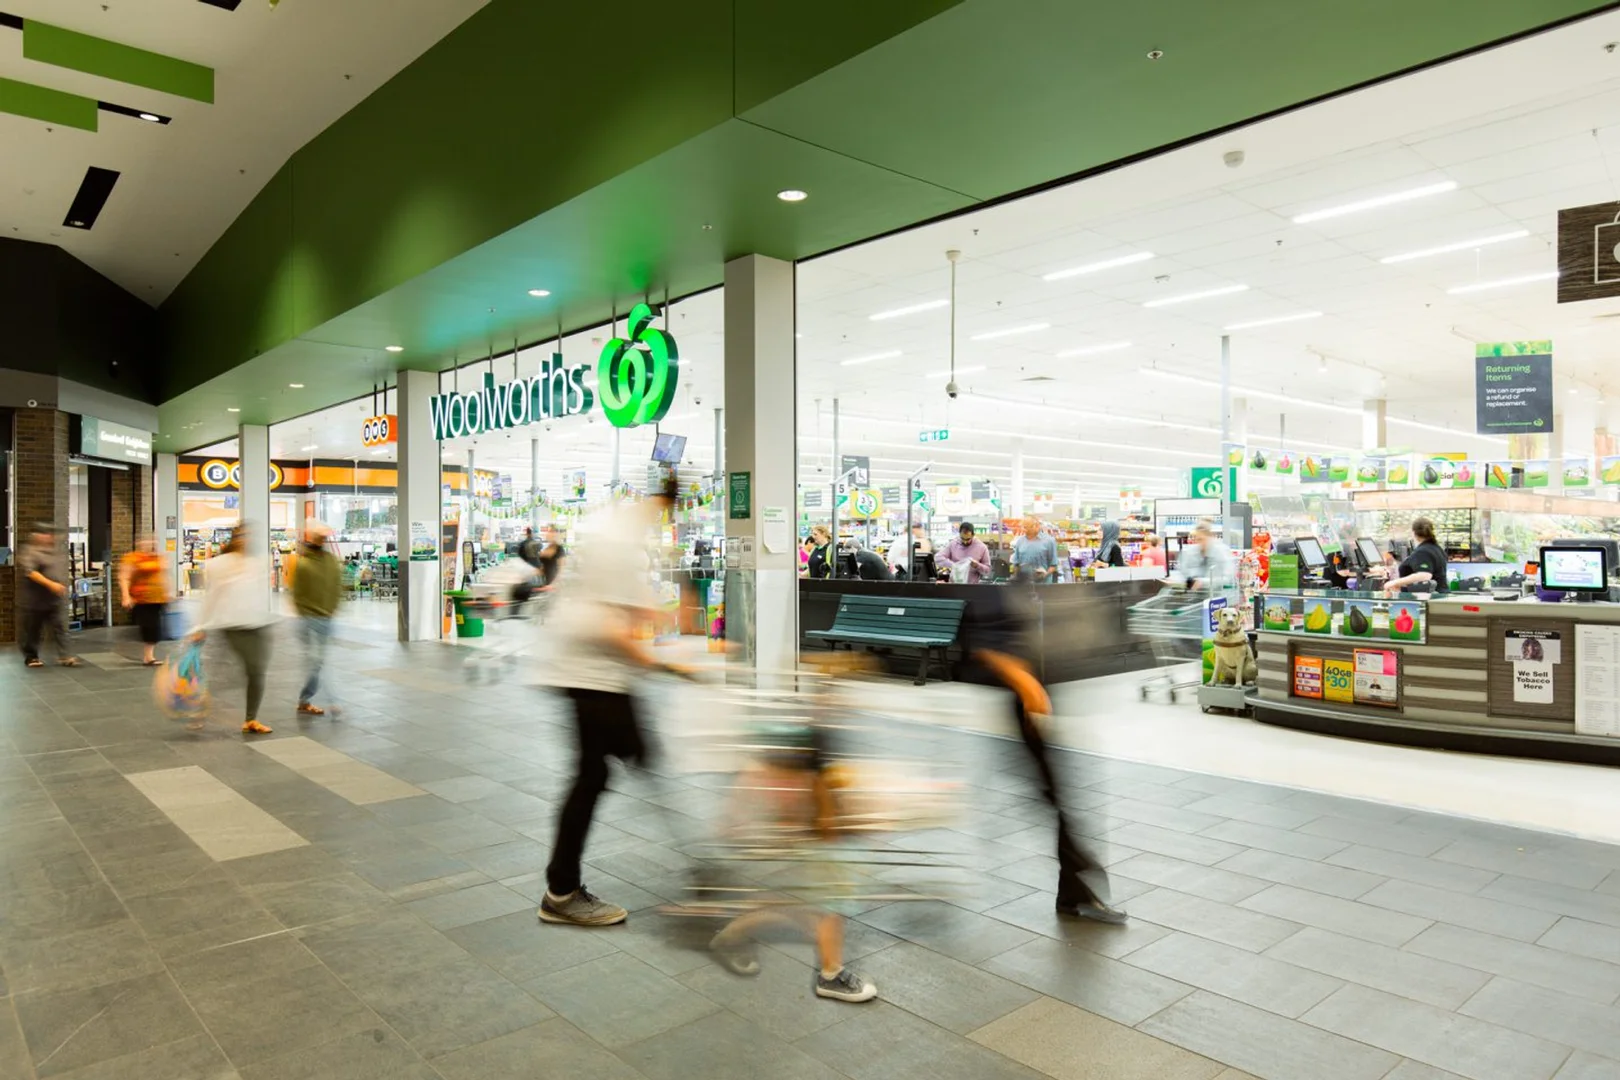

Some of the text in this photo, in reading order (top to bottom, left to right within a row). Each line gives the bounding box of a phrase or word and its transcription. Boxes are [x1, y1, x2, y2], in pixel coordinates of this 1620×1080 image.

[1485, 364, 1531, 374] Returning
[1510, 386, 1537, 395] organise
[1485, 400, 1528, 408] replacement.
[839, 484, 845, 493] 5
[914, 479, 921, 489] 4
[1326, 666, 1352, 677] 40GB
[1326, 675, 1348, 688] $30
[1516, 676, 1551, 684] Tobacco
